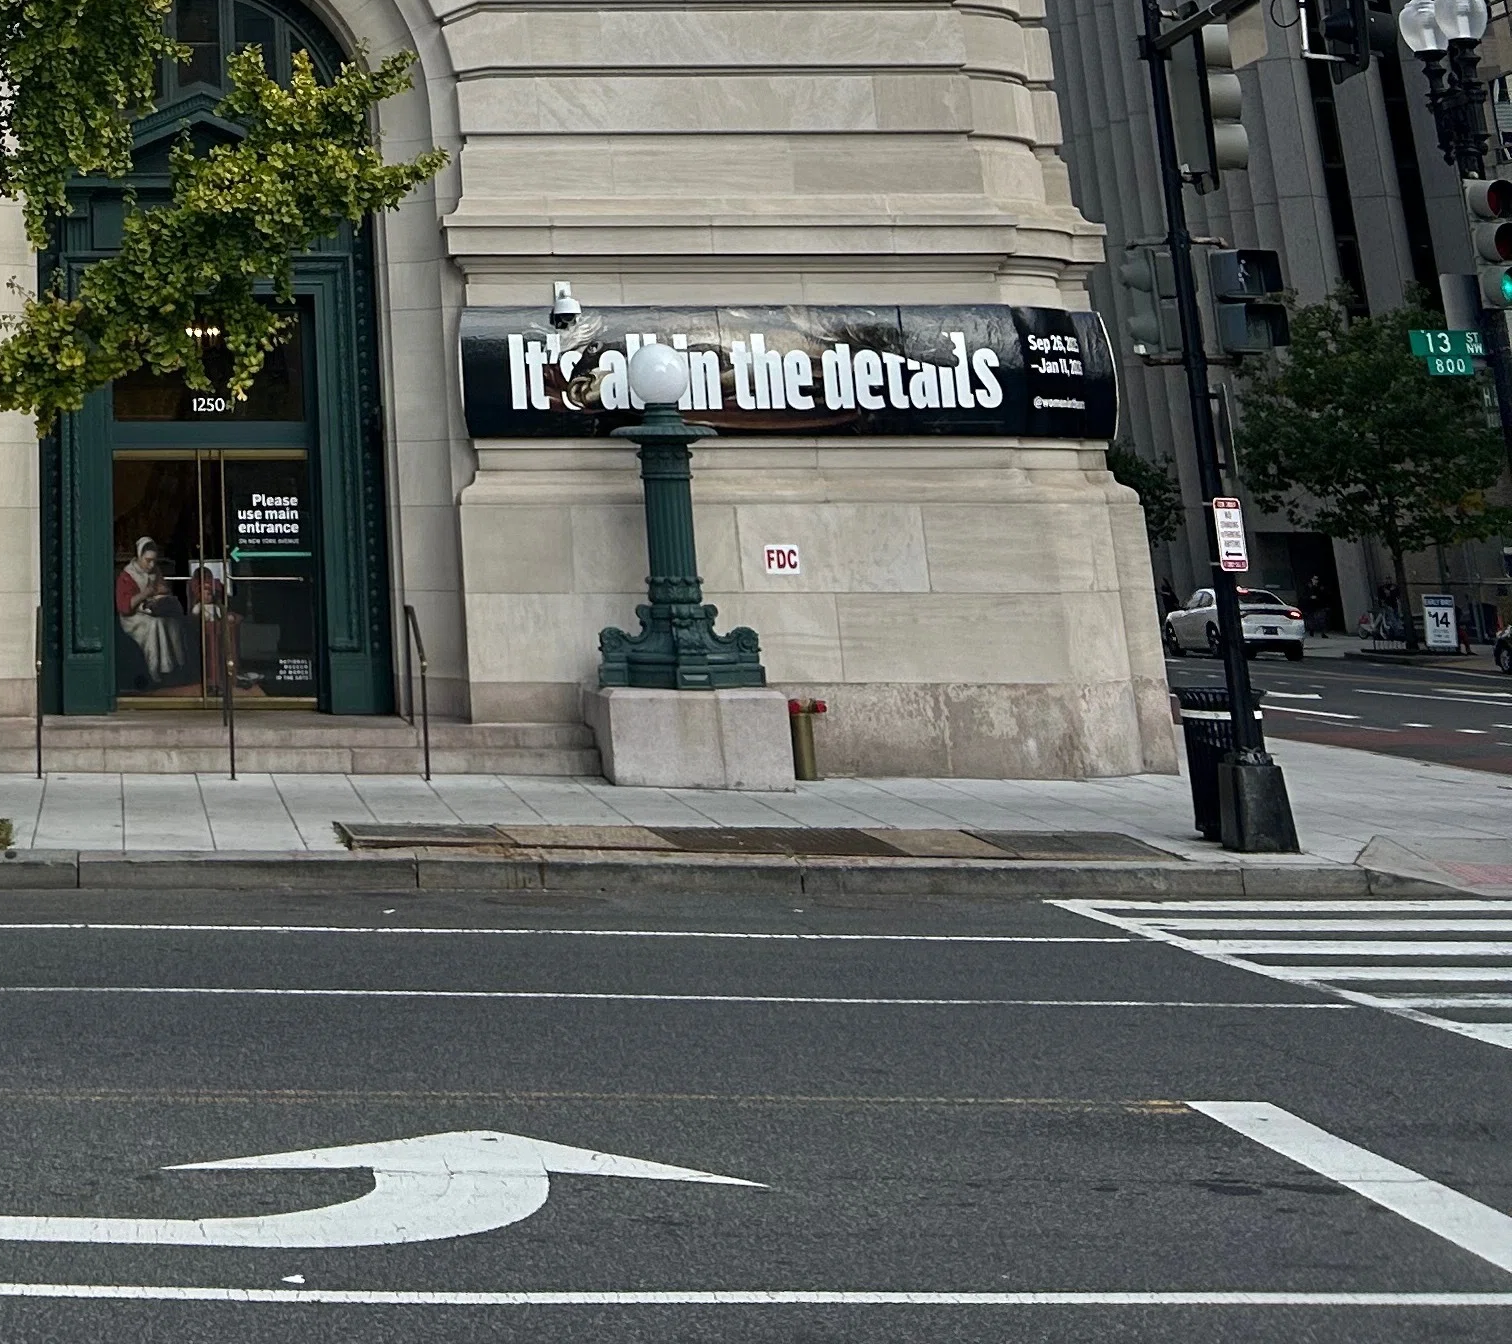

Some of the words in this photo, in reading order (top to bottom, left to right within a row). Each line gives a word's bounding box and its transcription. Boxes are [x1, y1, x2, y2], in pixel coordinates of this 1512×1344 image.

[1028, 334, 1050, 354] Sep
[1050, 334, 1067, 354] 26,
[1426, 332, 1451, 353] 13
[1465, 332, 1478, 343] ST
[1465, 343, 1484, 355] NW
[729, 333, 816, 410] the
[821, 331, 1004, 410] details
[1435, 358, 1465, 373] 800
[192, 397, 225, 412] 1250
[252, 493, 299, 507] Please
[237, 509, 262, 520] use
[264, 506, 299, 520] main
[237, 521, 300, 533] entrance
[766, 549, 798, 569] FDC
